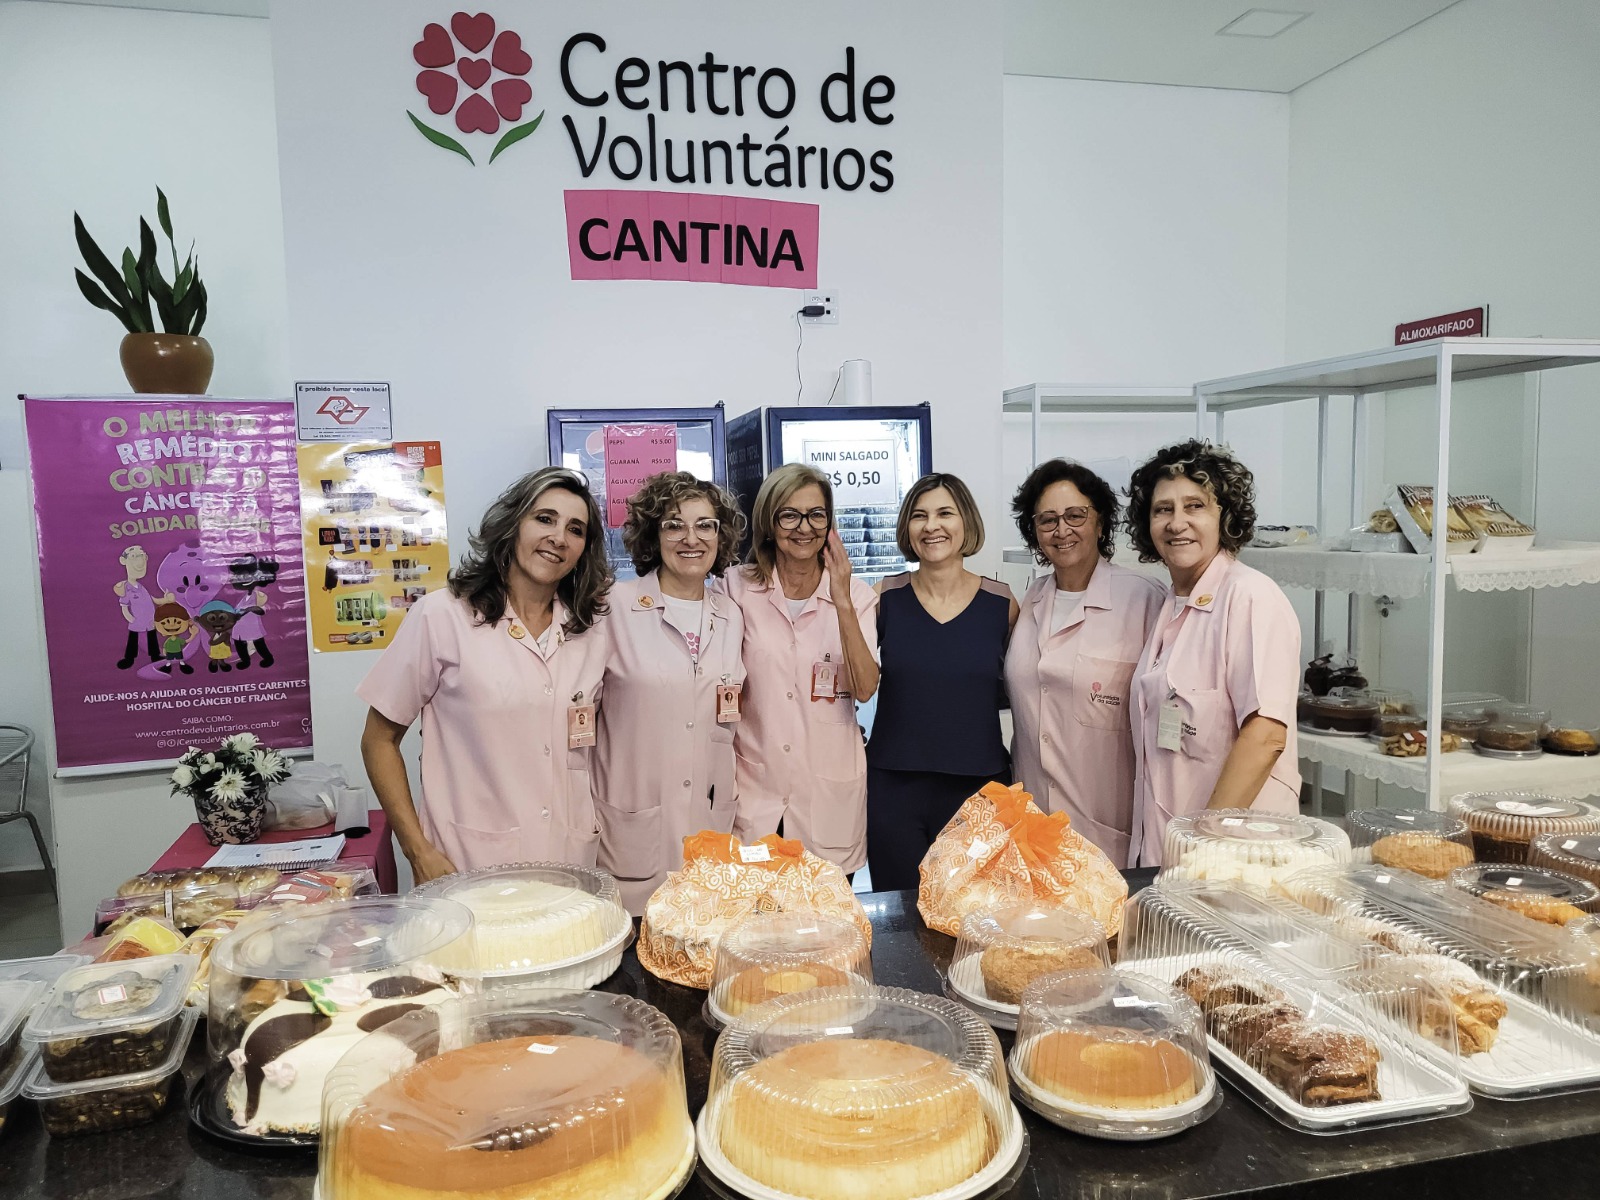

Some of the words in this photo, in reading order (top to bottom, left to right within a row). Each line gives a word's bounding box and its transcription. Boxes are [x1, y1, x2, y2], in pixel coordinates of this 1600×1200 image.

[560, 32, 796, 119] Centro
[820, 46, 896, 125] de
[562, 113, 896, 192] Voluntários
[578, 217, 805, 272] CANTINA
[1400, 318, 1474, 342] ALMOXARIFADO
[103, 416, 128, 438] O
[115, 432, 252, 465] REMÉDIO
[810, 452, 837, 462] MINI
[839, 451, 889, 461] SALGADO
[109, 462, 240, 492] CONTR
[847, 471, 881, 488] 0,50
[108, 515, 271, 539] SOLIDARIE
[83, 692, 139, 704] AJUDE-NOS
[140, 691, 148, 700] A
[150, 688, 187, 700] AJUDAR
[189, 687, 203, 696] OS
[205, 683, 257, 695] PACIENTES
[258, 680, 307, 692] CARENTES
[126, 701, 174, 712] HOSPITAL
[175, 699, 191, 709] DO
[192, 696, 232, 707] CÂNCER
[233, 695, 247, 704] DE
[135, 720, 281, 739] www.centrodevoluntarios.com.br
[181, 717, 205, 725] SAIBA
